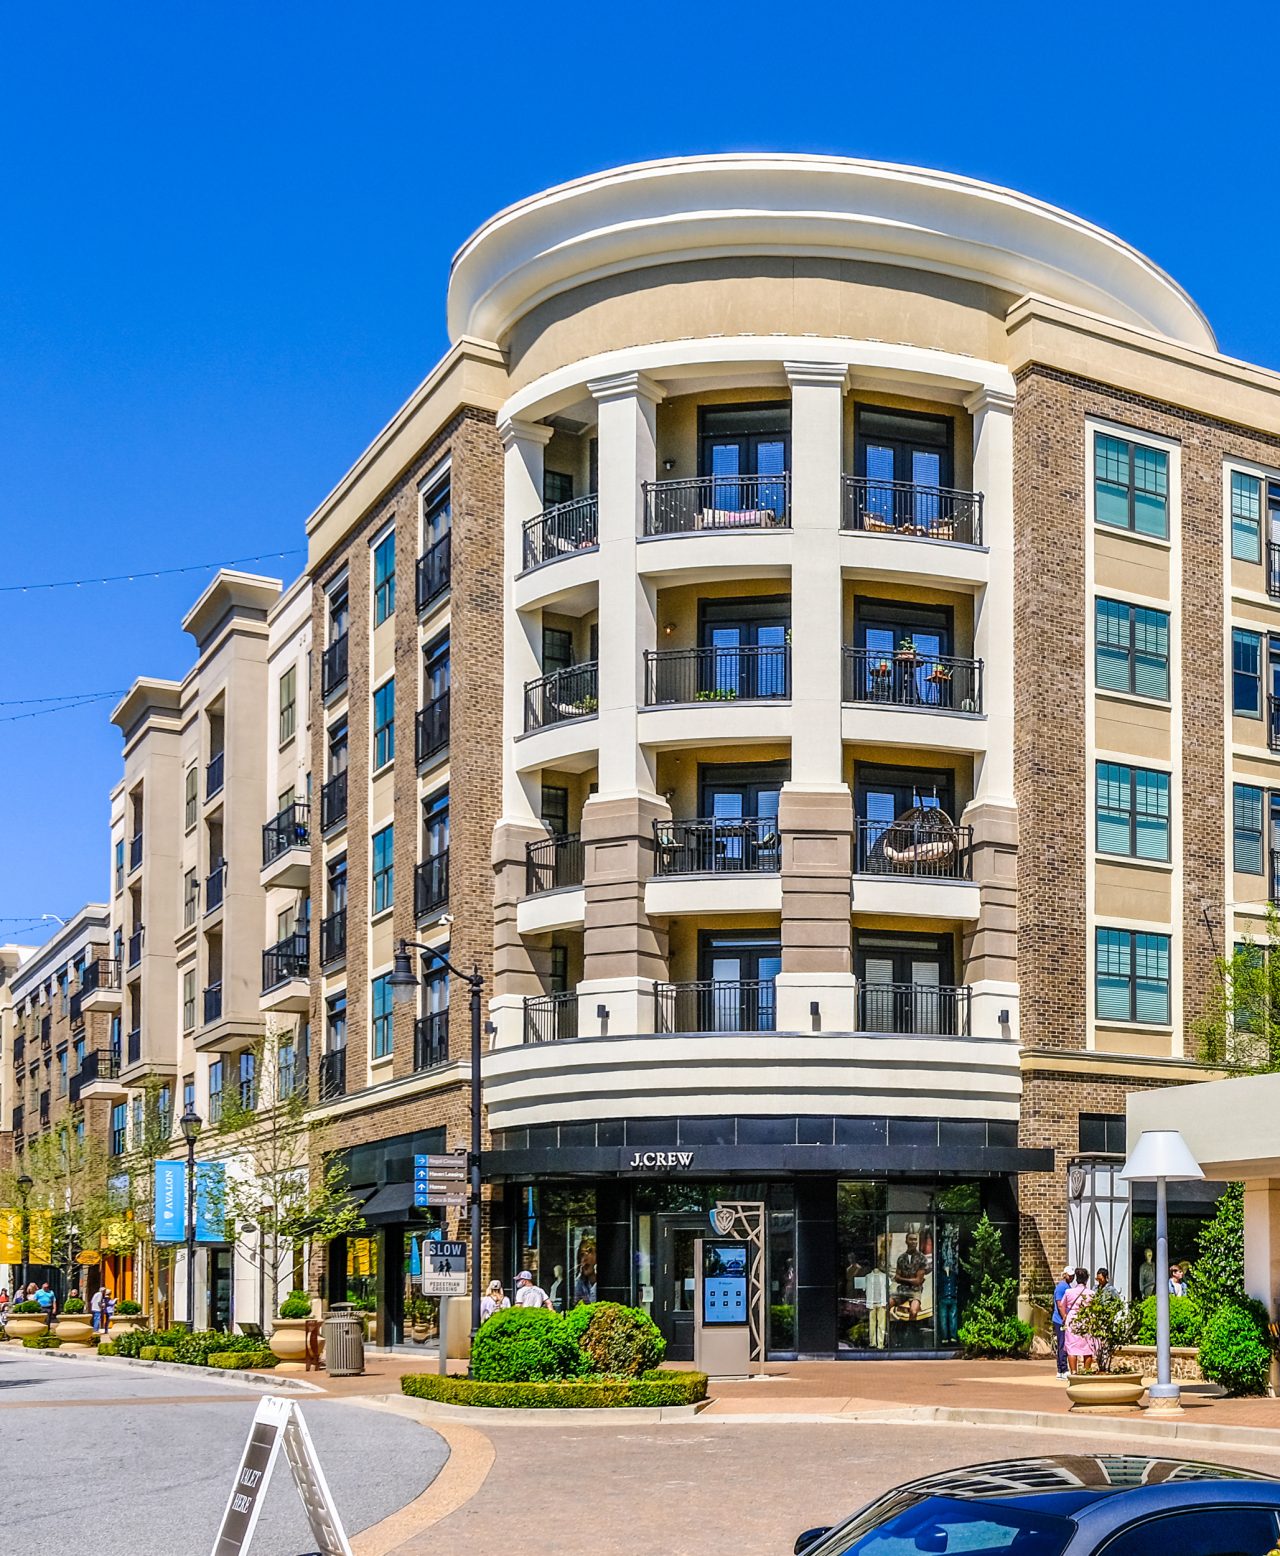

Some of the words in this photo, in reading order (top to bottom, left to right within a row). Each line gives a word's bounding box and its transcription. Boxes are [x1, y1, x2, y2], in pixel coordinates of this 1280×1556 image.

[630, 1152, 694, 1167] J.CREW
[165, 1170, 174, 1209] AVALON
[430, 1244, 462, 1255] SLOW
[241, 1468, 262, 1487] VALET
[232, 1494, 252, 1513] HERE
